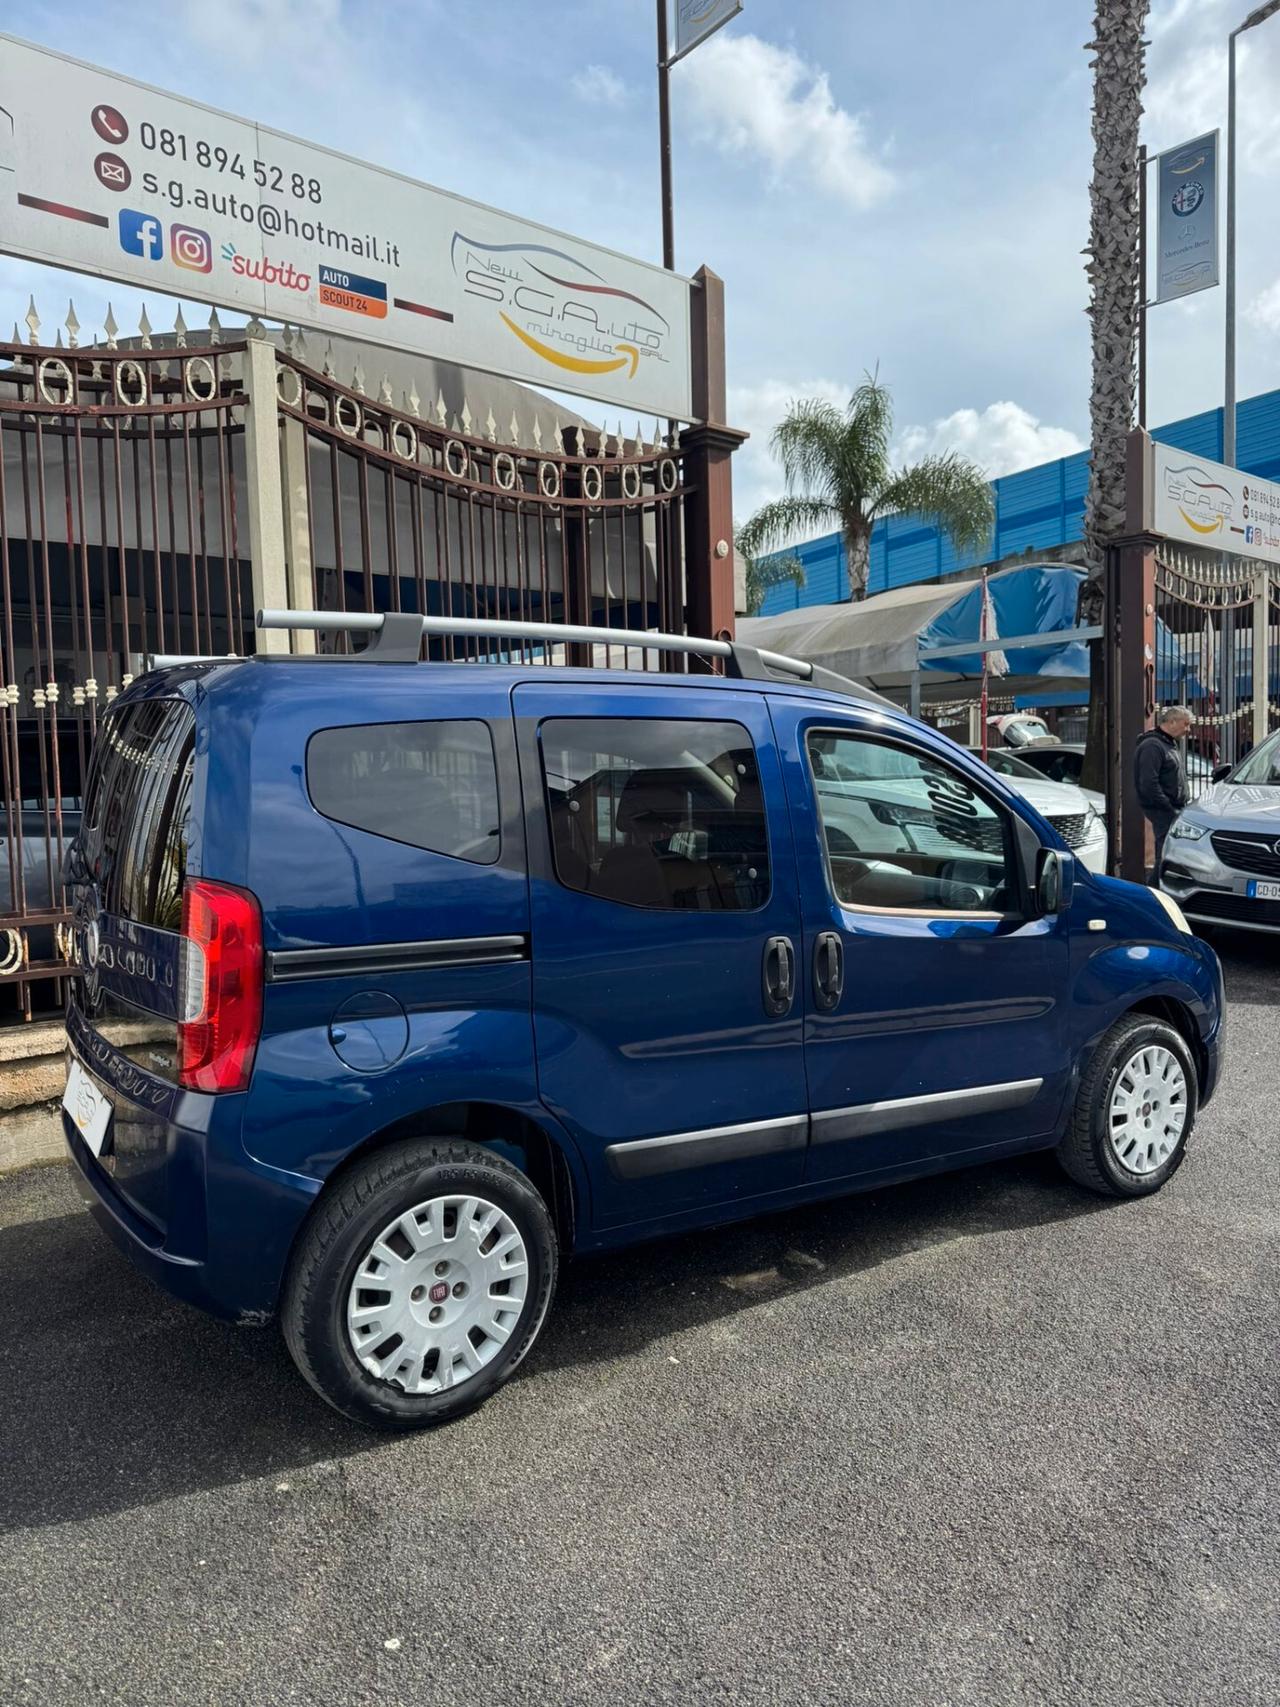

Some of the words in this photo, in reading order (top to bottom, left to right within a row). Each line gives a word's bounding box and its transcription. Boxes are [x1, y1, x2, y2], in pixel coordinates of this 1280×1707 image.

[140, 121, 188, 161] 081
[196, 140, 246, 180] 894
[253, 159, 284, 193] 52
[291, 172, 322, 204] 88
[142, 172, 400, 268] s.g.auto@hotmail.it
[231, 256, 312, 292] subito
[322, 269, 350, 288] AUTO
[465, 251, 524, 282] New
